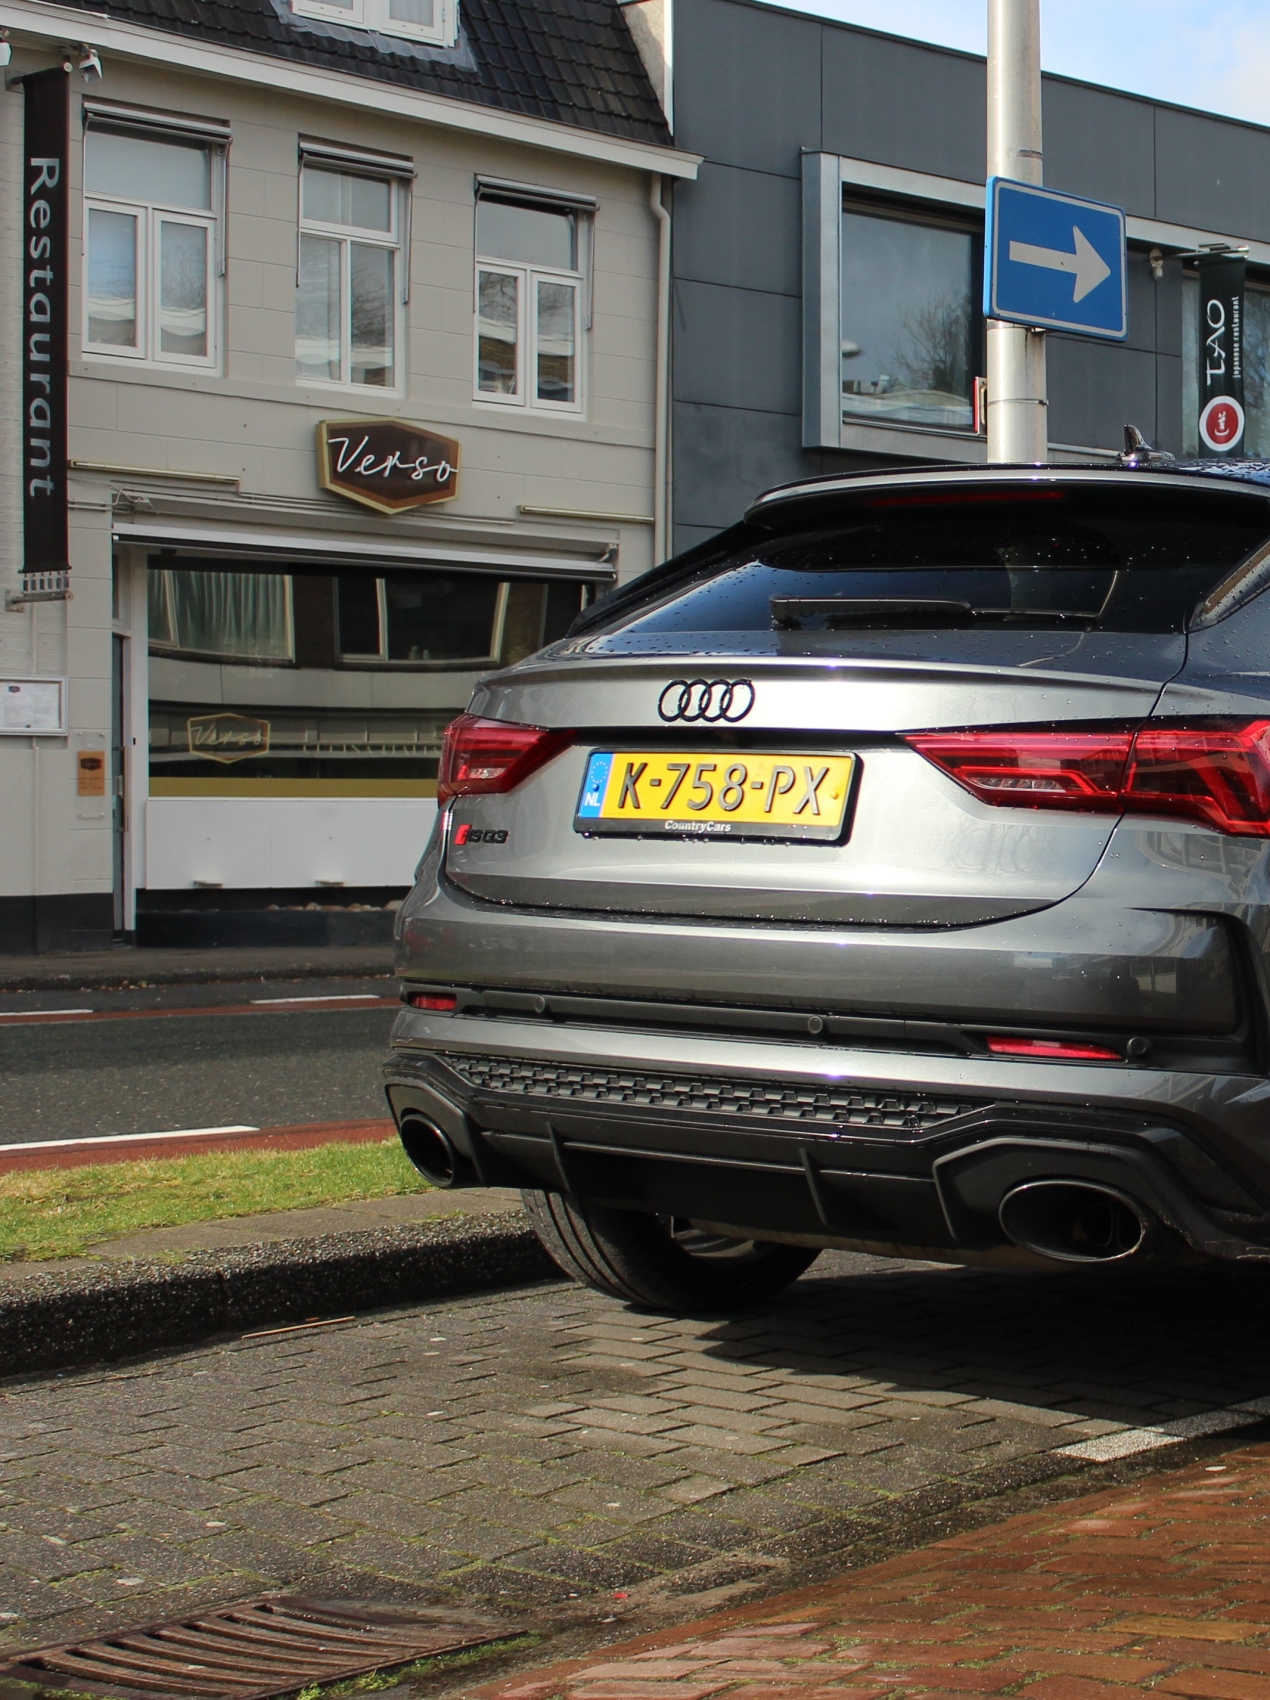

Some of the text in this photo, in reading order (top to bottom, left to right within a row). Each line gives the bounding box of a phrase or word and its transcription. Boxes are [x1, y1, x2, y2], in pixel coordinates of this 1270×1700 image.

[30, 158, 60, 497] Restaurant
[1206, 299, 1226, 386] TAO
[1231, 296, 1240, 340] restaurant
[328, 435, 459, 482] Verso
[584, 762, 829, 815] NL K-758-PX
[664, 819, 732, 833] CountryCars
